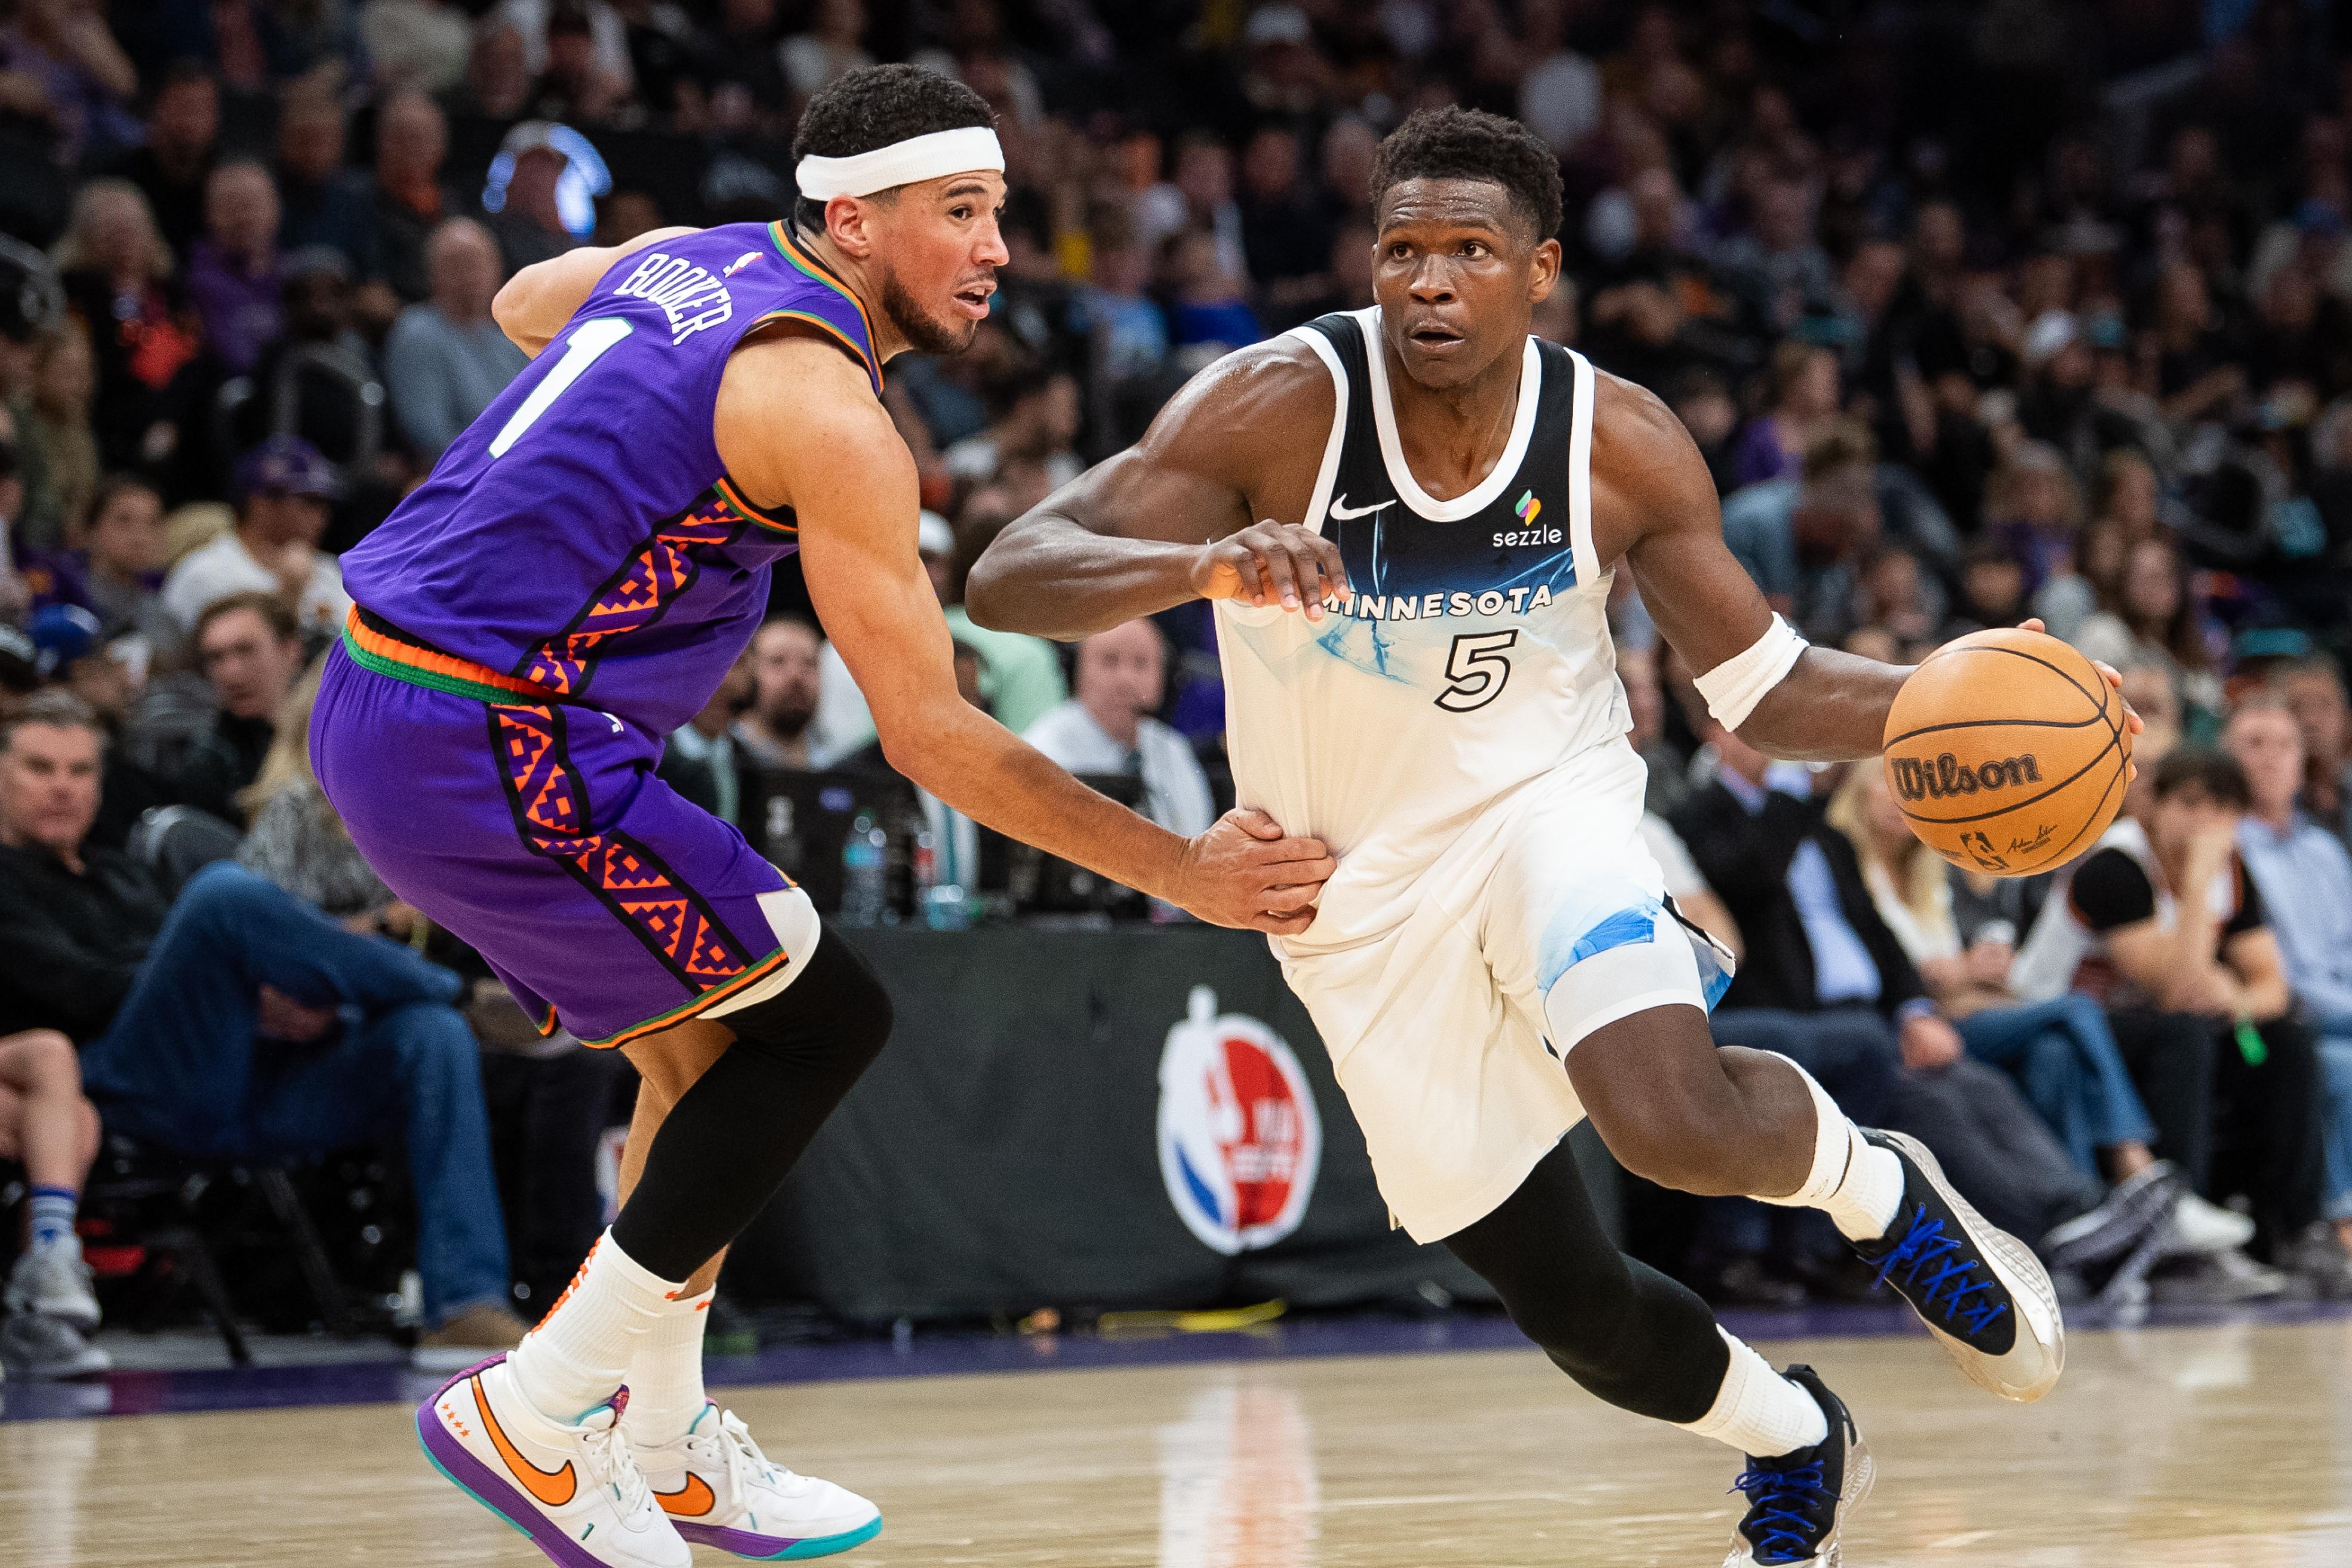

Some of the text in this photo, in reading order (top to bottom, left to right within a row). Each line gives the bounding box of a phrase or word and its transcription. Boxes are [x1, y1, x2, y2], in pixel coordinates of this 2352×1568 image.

[613, 252, 732, 346] BOOKER
[488, 317, 634, 459] 1
[1492, 523, 1562, 547] sezzle
[1433, 629, 1519, 713] 5
[1891, 753, 2043, 801] Wilson
